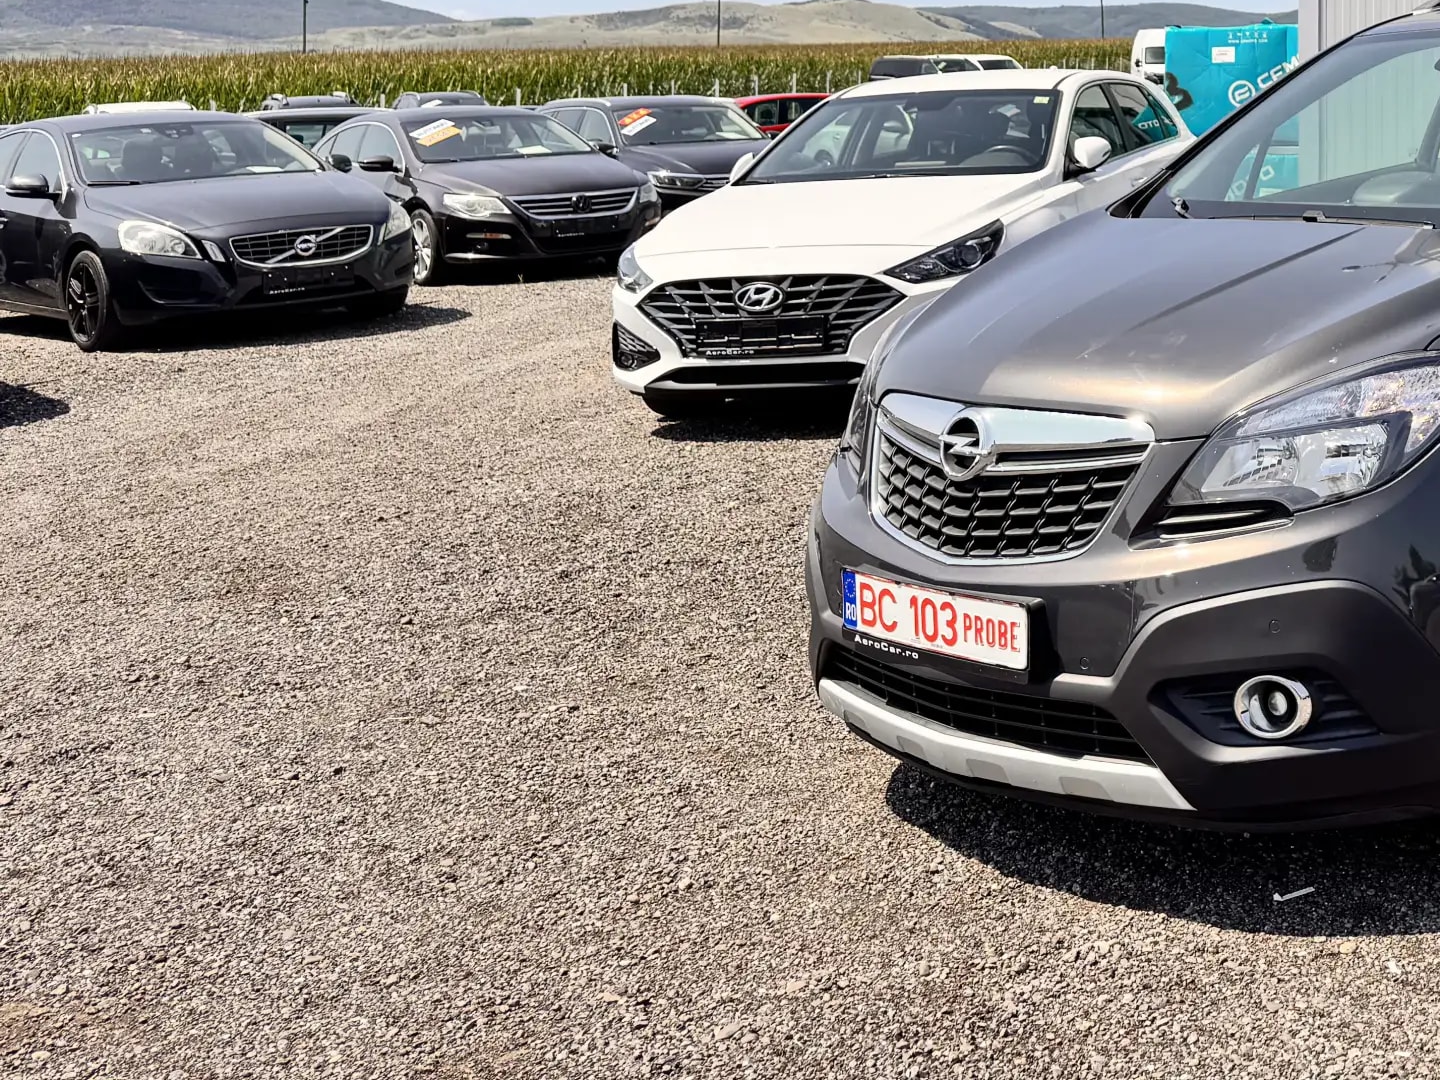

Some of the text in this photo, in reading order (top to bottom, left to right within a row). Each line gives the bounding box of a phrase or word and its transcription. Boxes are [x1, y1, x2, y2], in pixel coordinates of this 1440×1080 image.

[1256, 54, 1299, 89] CFM
[845, 601, 857, 621] RO
[859, 581, 1021, 653] BC 103 PROBE
[854, 633, 919, 660] AeroCar.ro
